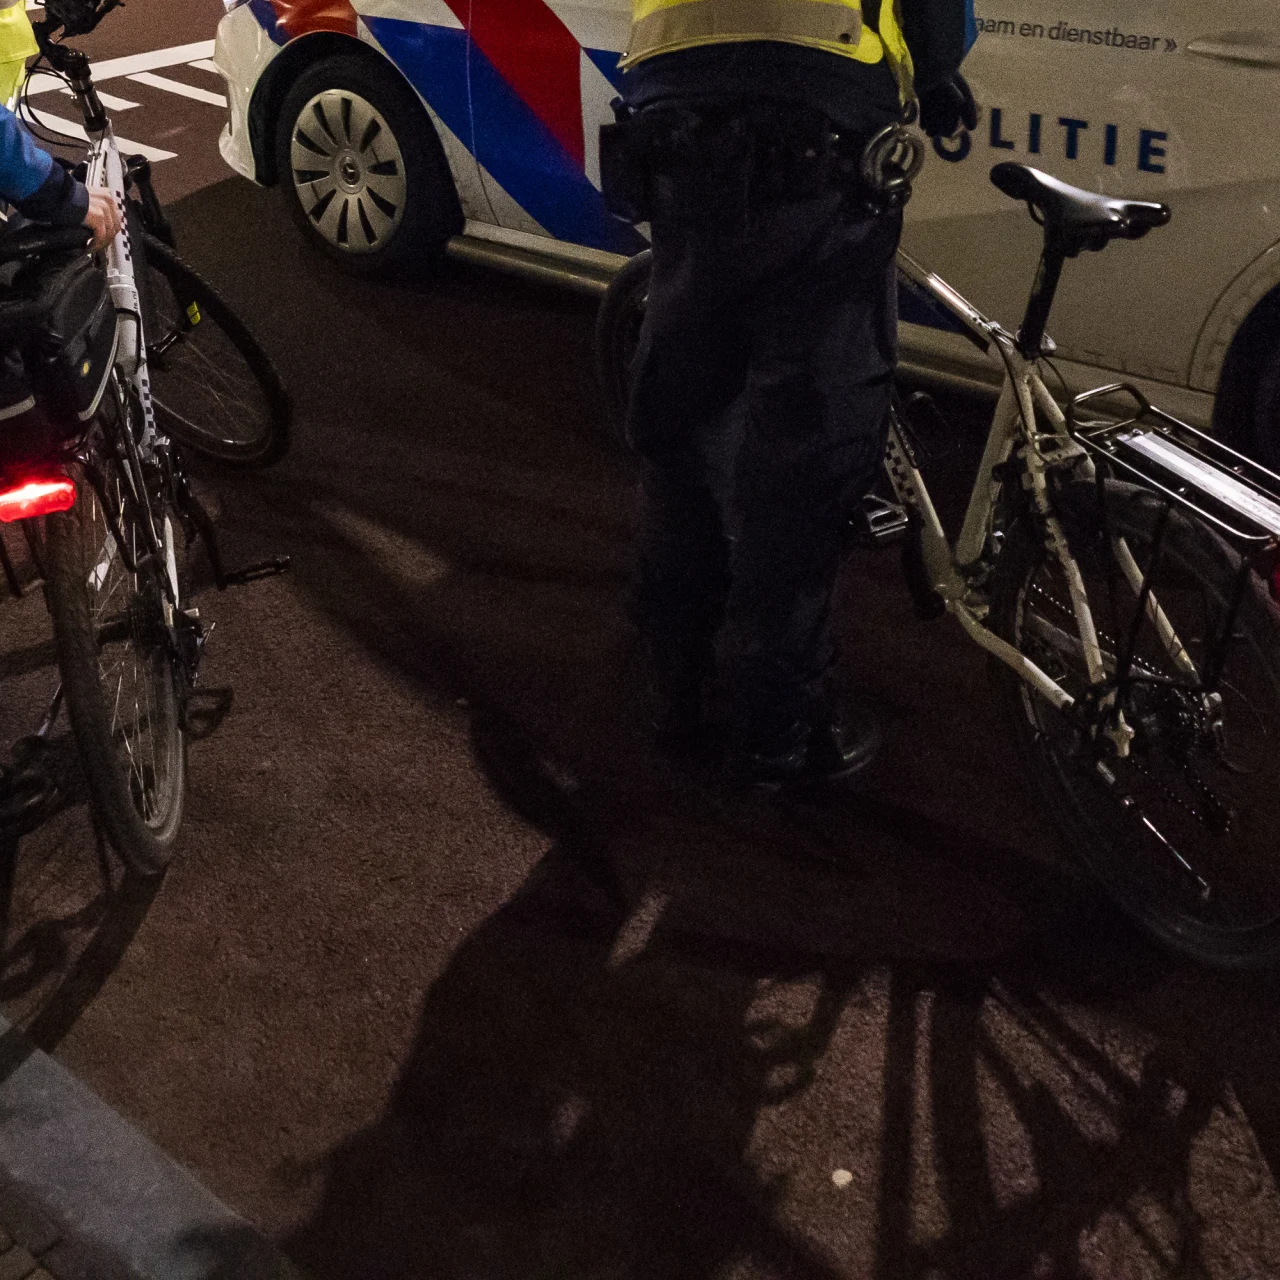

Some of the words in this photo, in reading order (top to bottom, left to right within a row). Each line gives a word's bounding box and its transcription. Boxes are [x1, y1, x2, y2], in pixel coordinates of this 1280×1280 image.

[1019, 22, 1044, 38] en
[1048, 20, 1160, 51] dienstbaar
[932, 107, 1168, 174] OLITIE
